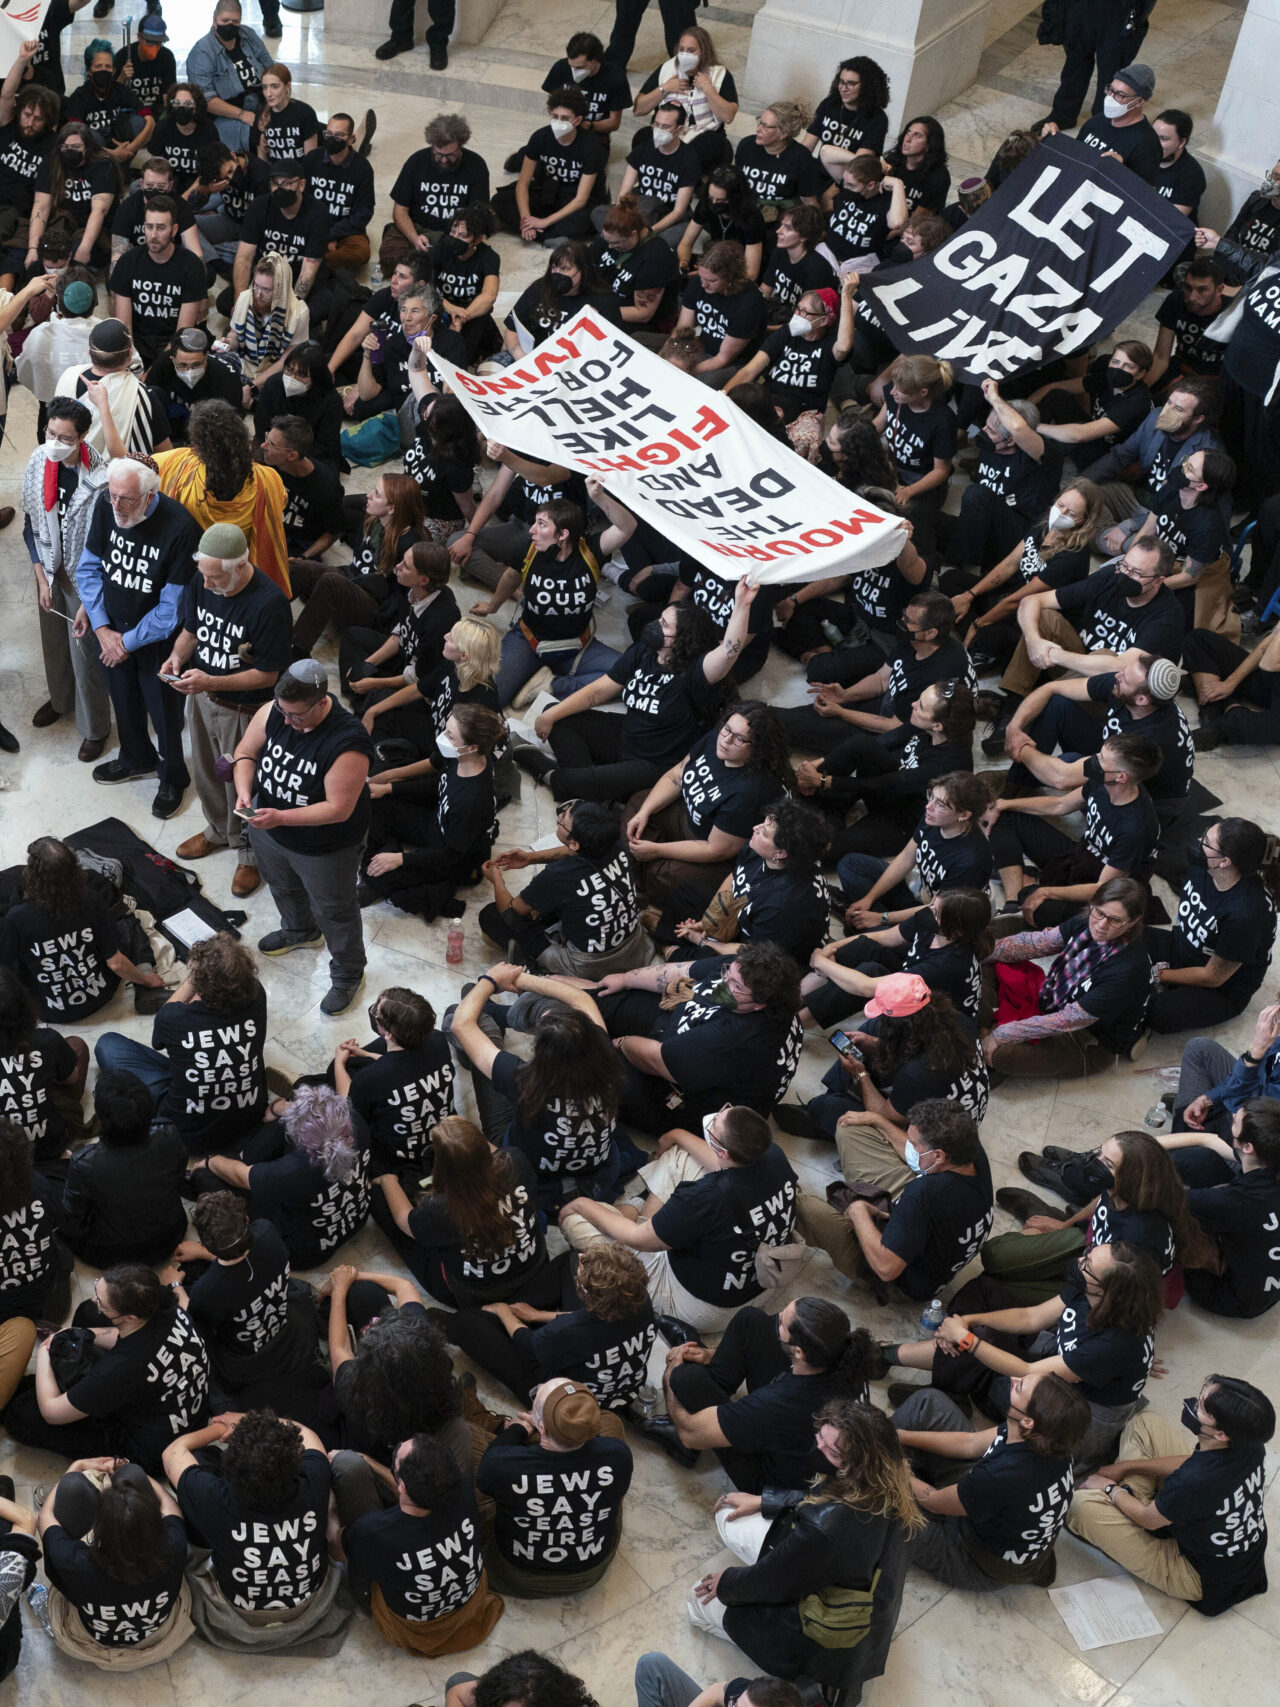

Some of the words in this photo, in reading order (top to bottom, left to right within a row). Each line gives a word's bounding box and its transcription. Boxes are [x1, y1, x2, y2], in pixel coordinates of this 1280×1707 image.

[287, 127, 299, 136] IN
[822, 131, 851, 149] OUR
[823, 116, 847, 133] NOT
[849, 128, 863, 140] IN
[267, 138, 295, 148] OUR
[312, 177, 336, 189] NOT
[341, 183, 354, 193] IN
[421, 182, 449, 192] NOT
[454, 184, 467, 194] IN
[642, 176, 672, 192] OUR
[667, 172, 678, 183] IN
[743, 166, 769, 179] NOT
[771, 174, 786, 184] IN
[314, 189, 346, 204] OUR
[426, 194, 459, 206] OUR
[830, 214, 871, 246] NAME
[839, 209, 868, 234] OUR
[1008, 165, 1170, 293] LET
[265, 230, 288, 241] NOT
[293, 236, 304, 245] IN
[133, 280, 161, 292] NOT
[167, 285, 181, 295] IN
[139, 292, 172, 306] OUR
[933, 230, 1104, 355] GAZA
[133, 303, 178, 318] NAME
[455, 317, 607, 396] LIVING
[553, 340, 635, 390] FOR
[771, 361, 817, 387] NAME
[470, 387, 558, 416] THE
[512, 377, 651, 427] HELL
[552, 404, 677, 455] LIKE
[574, 405, 730, 472] FIGHT
[637, 454, 723, 491] AND
[699, 508, 886, 562] MOURN
[706, 514, 804, 541] THE
[110, 530, 135, 553] NOT
[142, 545, 159, 560] IN
[102, 555, 152, 593] NAME
[111, 549, 148, 574] OUR
[531, 574, 567, 590] NOT
[575, 574, 590, 589] IN
[528, 601, 593, 615] NAME
[537, 592, 586, 605] OUR
[197, 606, 223, 629] NOT
[226, 622, 243, 638] IN
[1094, 610, 1127, 632] NOT
[197, 626, 231, 652] OUR
[1095, 621, 1127, 652] OUR
[267, 738, 294, 765] NOT
[297, 759, 316, 775] IN
[262, 757, 305, 794] OUR
[576, 851, 631, 896] JEWS
[591, 872, 632, 911] SAY
[1184, 880, 1207, 913] NOT
[1179, 901, 1207, 948] OUR
[31, 928, 93, 961] JEWS
[37, 954, 97, 988] CEASE
[41, 944, 87, 976] SAY
[46, 971, 106, 1010] NOW
[51, 977, 90, 996] FIRE
[182, 1020, 256, 1049] JEWS
[185, 1056, 257, 1082] CEASE
[195, 1042, 251, 1068] SAY
[186, 1084, 258, 1113] NOW
[198, 1077, 251, 1097] FIRE
[388, 1064, 452, 1105] JEWS
[401, 1083, 448, 1121] SAY
[544, 1117, 616, 1148] CEASE
[464, 1239, 536, 1278] NOW
[147, 1308, 196, 1387] JEWS
[162, 1327, 203, 1388] SAY
[585, 1324, 658, 1369] JEWS
[512, 1466, 613, 1494] JEWS
[527, 1491, 601, 1516] SAY
[232, 1511, 316, 1543] JEWS
[514, 1508, 611, 1530] CEASE
[396, 1518, 474, 1570] JEWS
[513, 1533, 604, 1562] NOW
[528, 1527, 594, 1545] FIRE
[232, 1547, 320, 1584] CEASE
[244, 1538, 310, 1568] SAY
[415, 1545, 477, 1595] SAY
[248, 1578, 310, 1598] FIRE
[82, 1592, 168, 1620] JEWS
